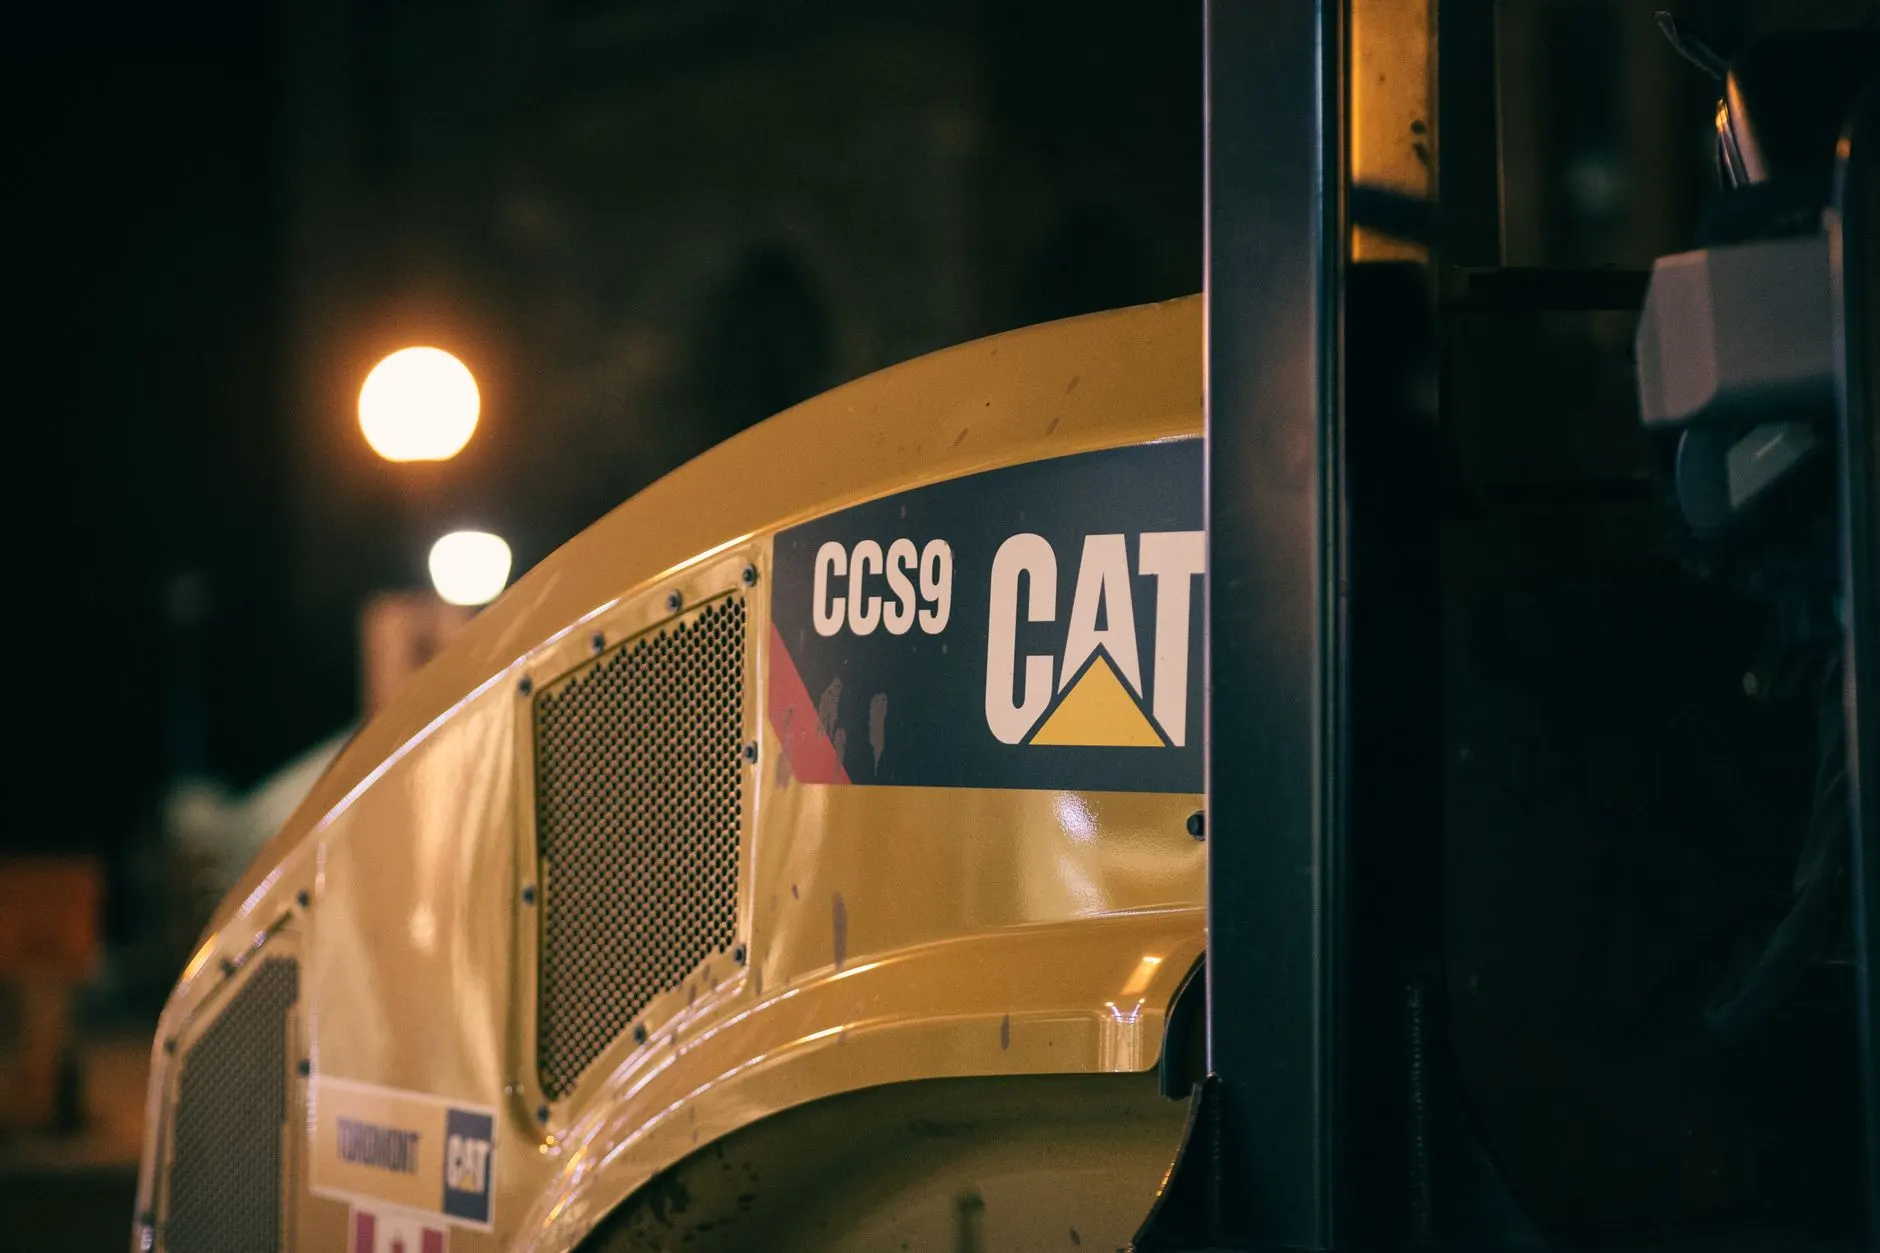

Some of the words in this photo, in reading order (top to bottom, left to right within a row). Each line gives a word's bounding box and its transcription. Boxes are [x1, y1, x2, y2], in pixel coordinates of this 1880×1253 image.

[812, 538, 953, 637] CCS9
[985, 531, 1207, 747] CAT
[448, 1133, 489, 1194] CAT
